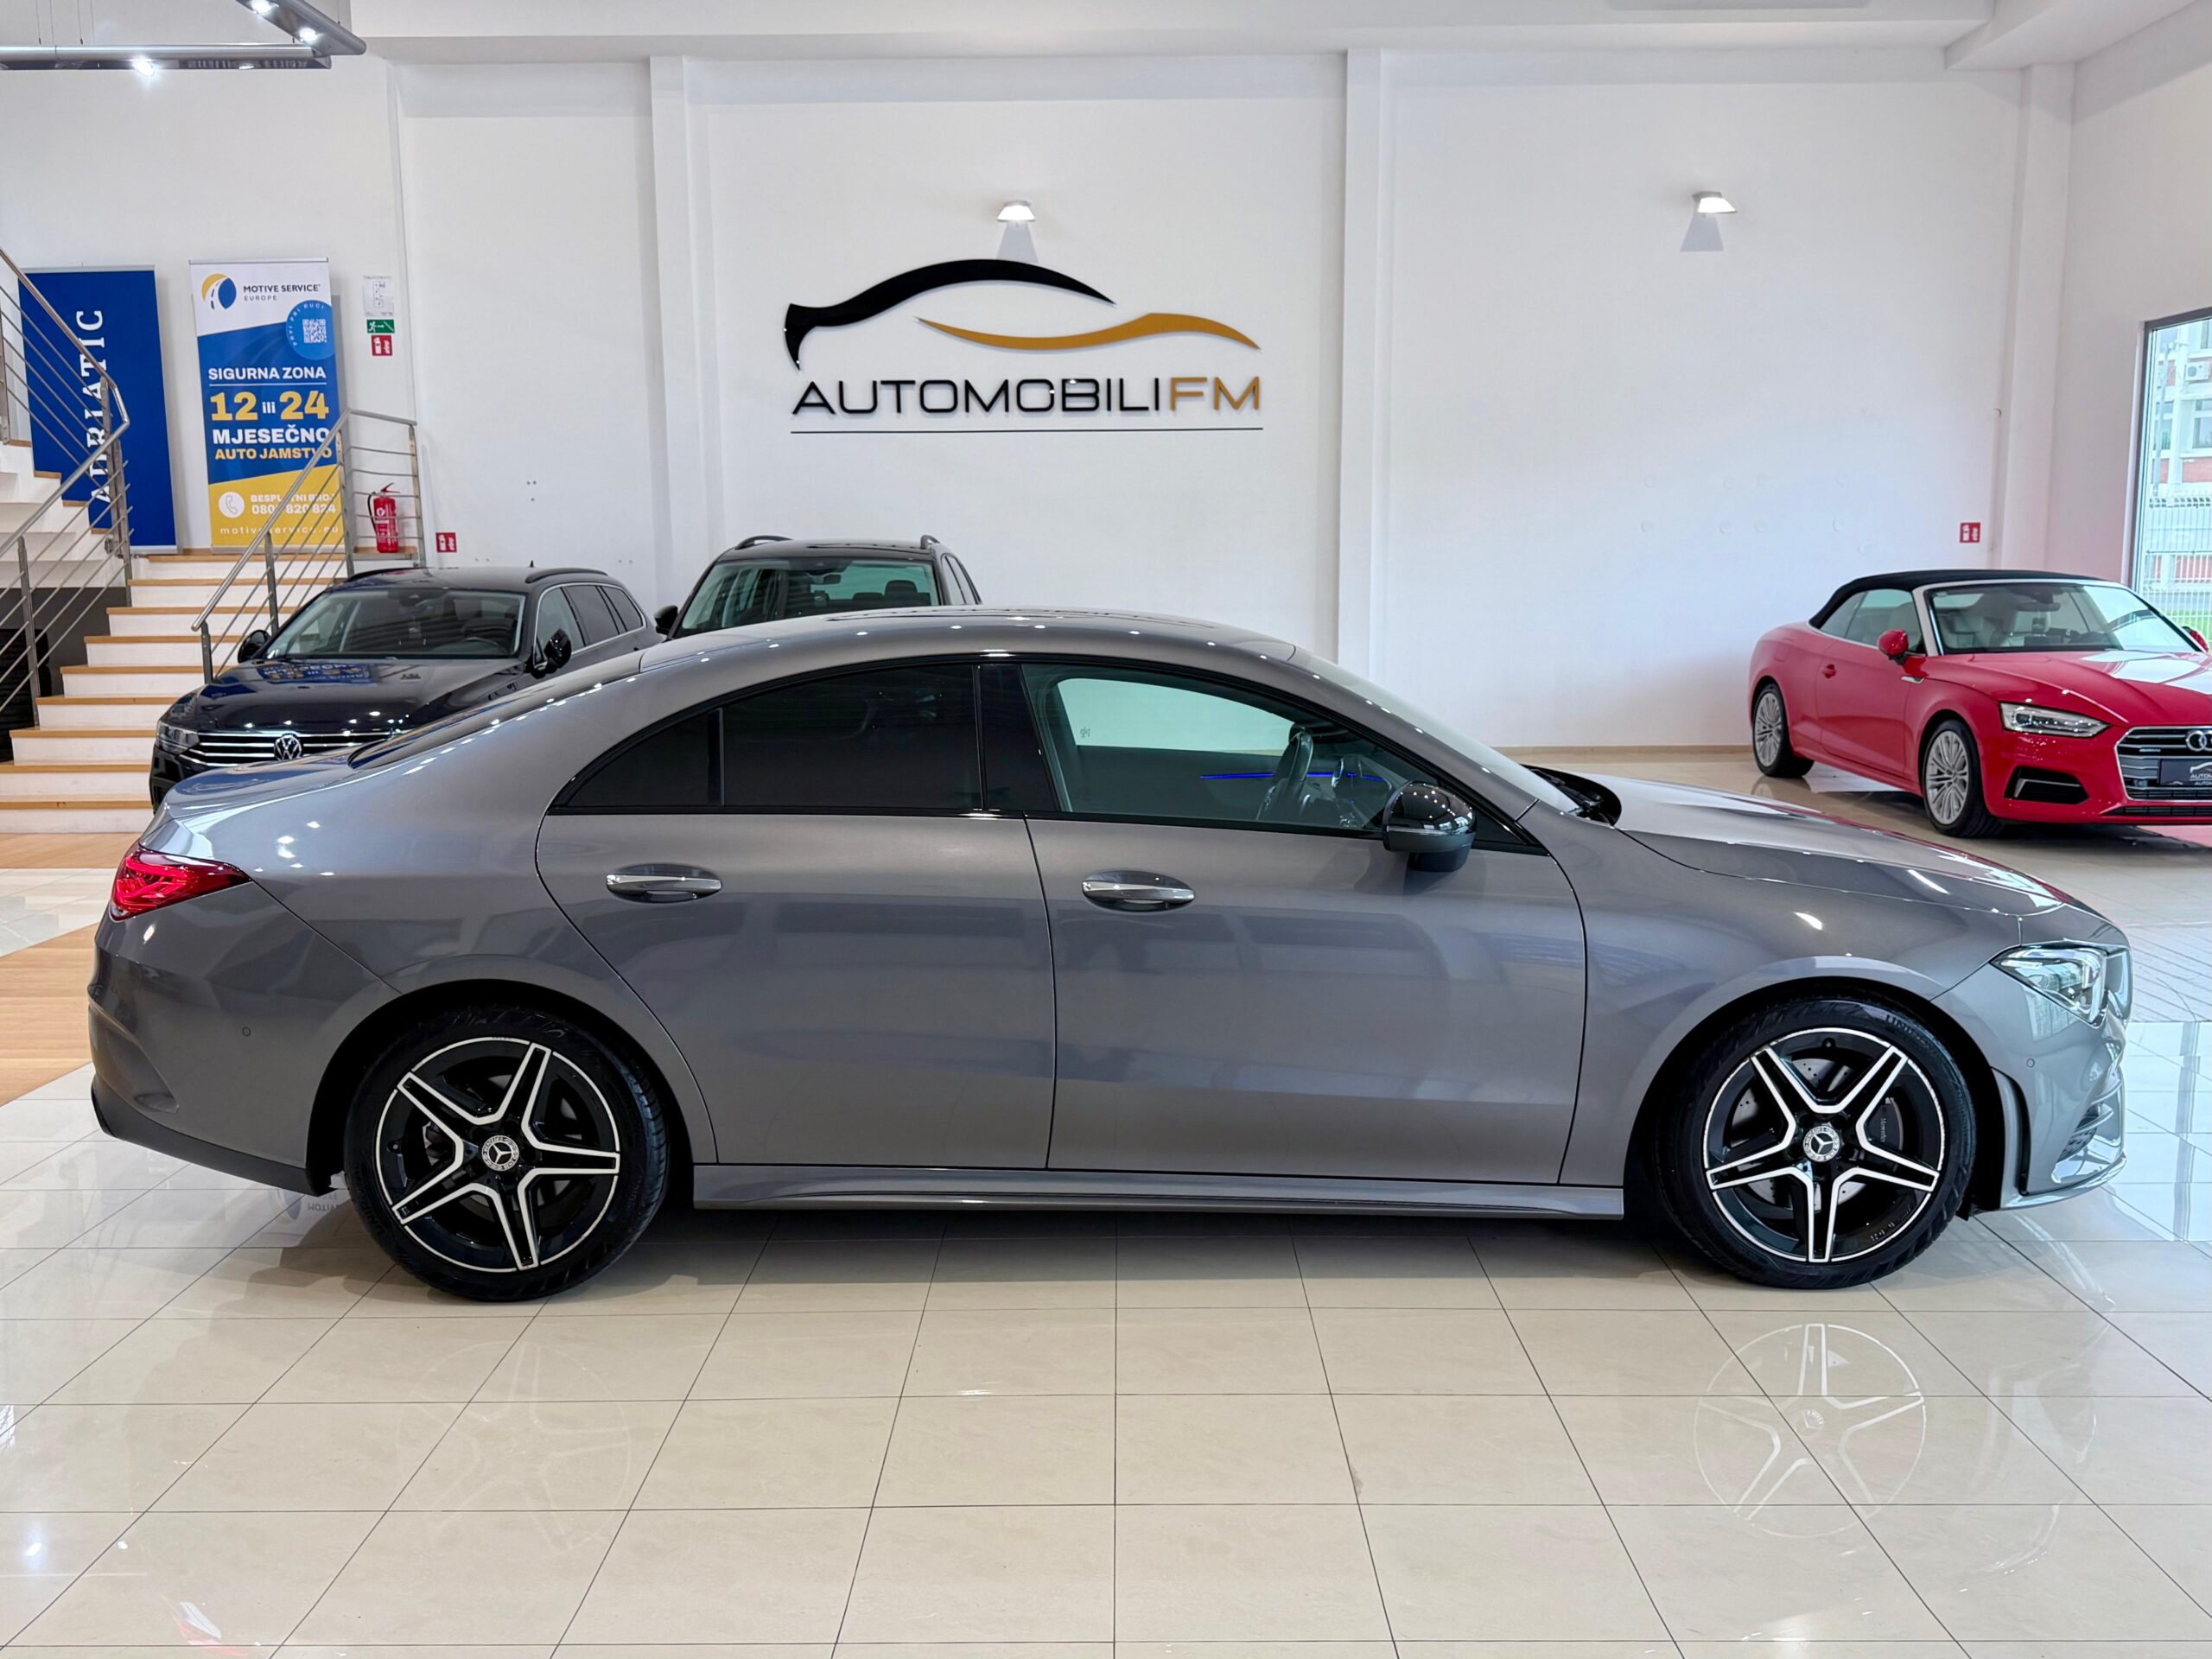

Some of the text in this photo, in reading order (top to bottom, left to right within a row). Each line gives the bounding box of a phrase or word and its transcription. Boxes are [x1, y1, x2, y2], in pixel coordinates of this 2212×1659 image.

[208, 366, 326, 380] SIGURNA ZONA
[792, 376, 1260, 415] AUTOMOBILIFM
[210, 391, 329, 421] 12 ili 24
[213, 424, 330, 444] MJESEČNO
[215, 448, 257, 460] AUTO
[251, 505, 277, 514] 080
